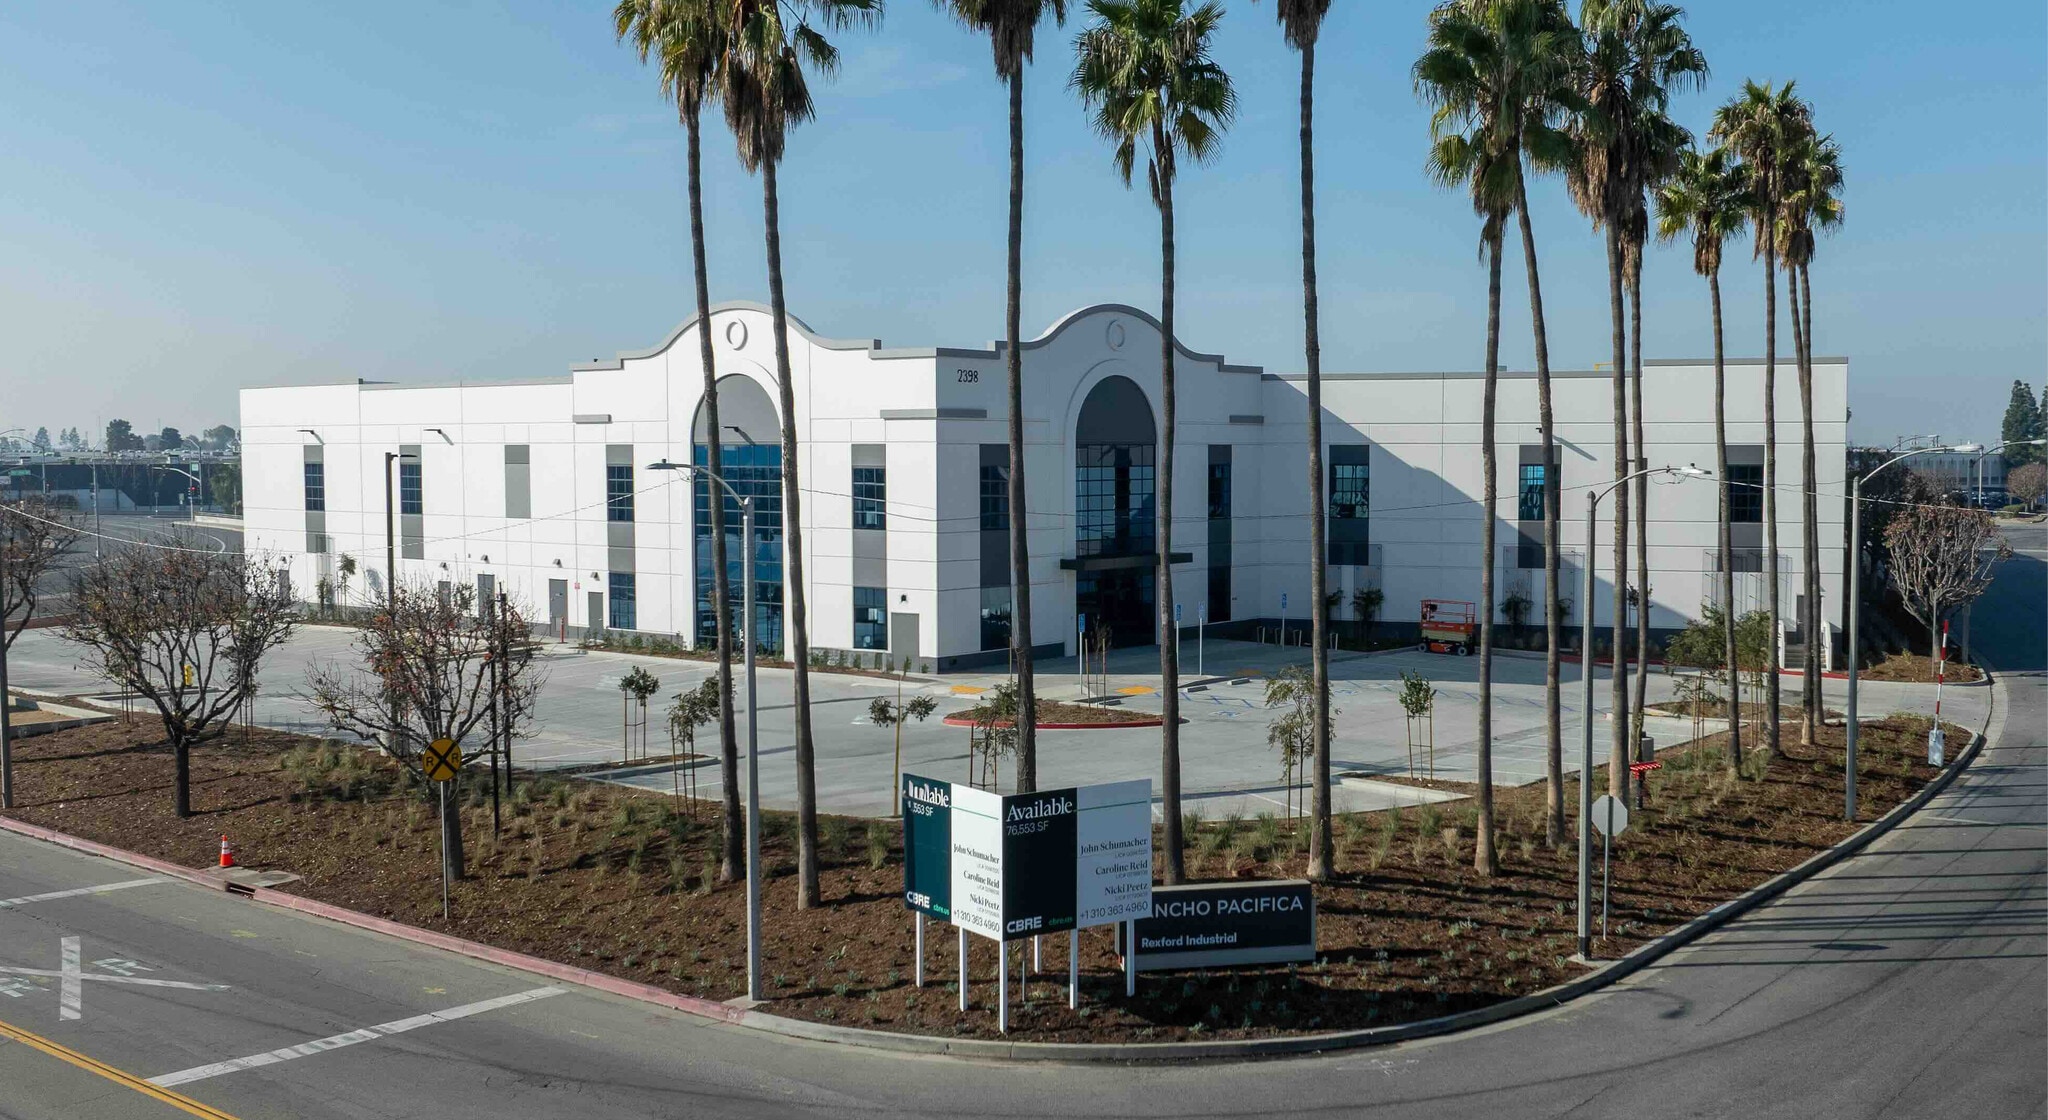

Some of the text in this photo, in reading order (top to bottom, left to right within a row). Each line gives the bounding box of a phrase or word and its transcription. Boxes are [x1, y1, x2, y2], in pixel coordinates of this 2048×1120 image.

[957, 369, 979, 383] 2398
[426, 753, 459, 766] R R
[925, 806, 934, 817] SF
[1006, 797, 1073, 822] Available
[1007, 820, 1049, 836] 76,553 SF
[953, 843, 1000, 864] John Schumacher
[1081, 838, 1148, 855] John Schumacher
[1095, 864, 1129, 875] Caroline
[1130, 860, 1148, 870] Reid
[964, 870, 1000, 889] Caroline Reid
[1104, 885, 1126, 895] Nicki
[1126, 883, 1148, 892] Peetz
[906, 891, 930, 909] CBRE
[969, 893, 984, 906] Nicki
[1152, 896, 1303, 918] NCHO PACIFICA
[1080, 901, 1148, 919] +1 310 363 4960
[960, 911, 971, 922] 310
[983, 919, 1000, 932] 4960
[1006, 916, 1042, 933] CBRE
[1141, 932, 1237, 948] Rexford Industrial
